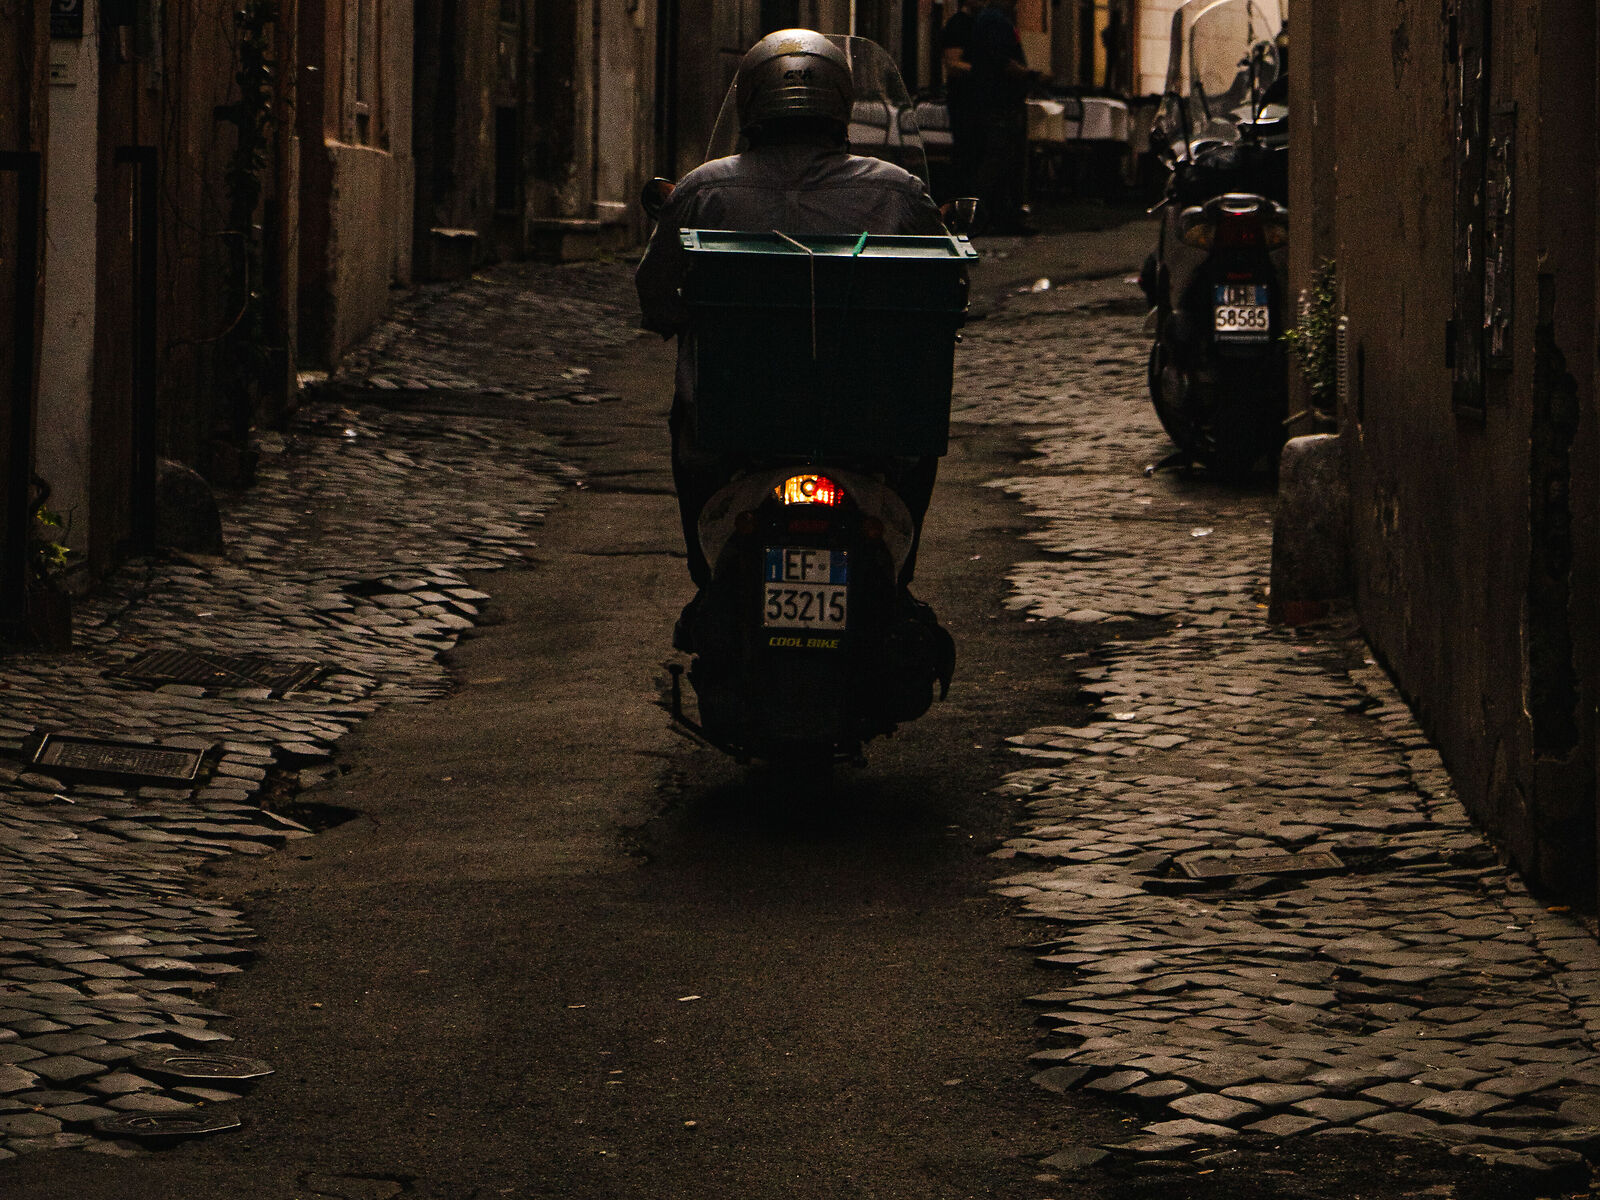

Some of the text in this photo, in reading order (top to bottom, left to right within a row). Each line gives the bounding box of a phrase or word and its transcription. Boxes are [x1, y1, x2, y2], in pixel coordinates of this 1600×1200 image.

[1216, 309, 1266, 328] 58585
[785, 549, 817, 580] EF
[768, 589, 844, 622] 33215
[768, 636, 839, 649] COOL BIKE
